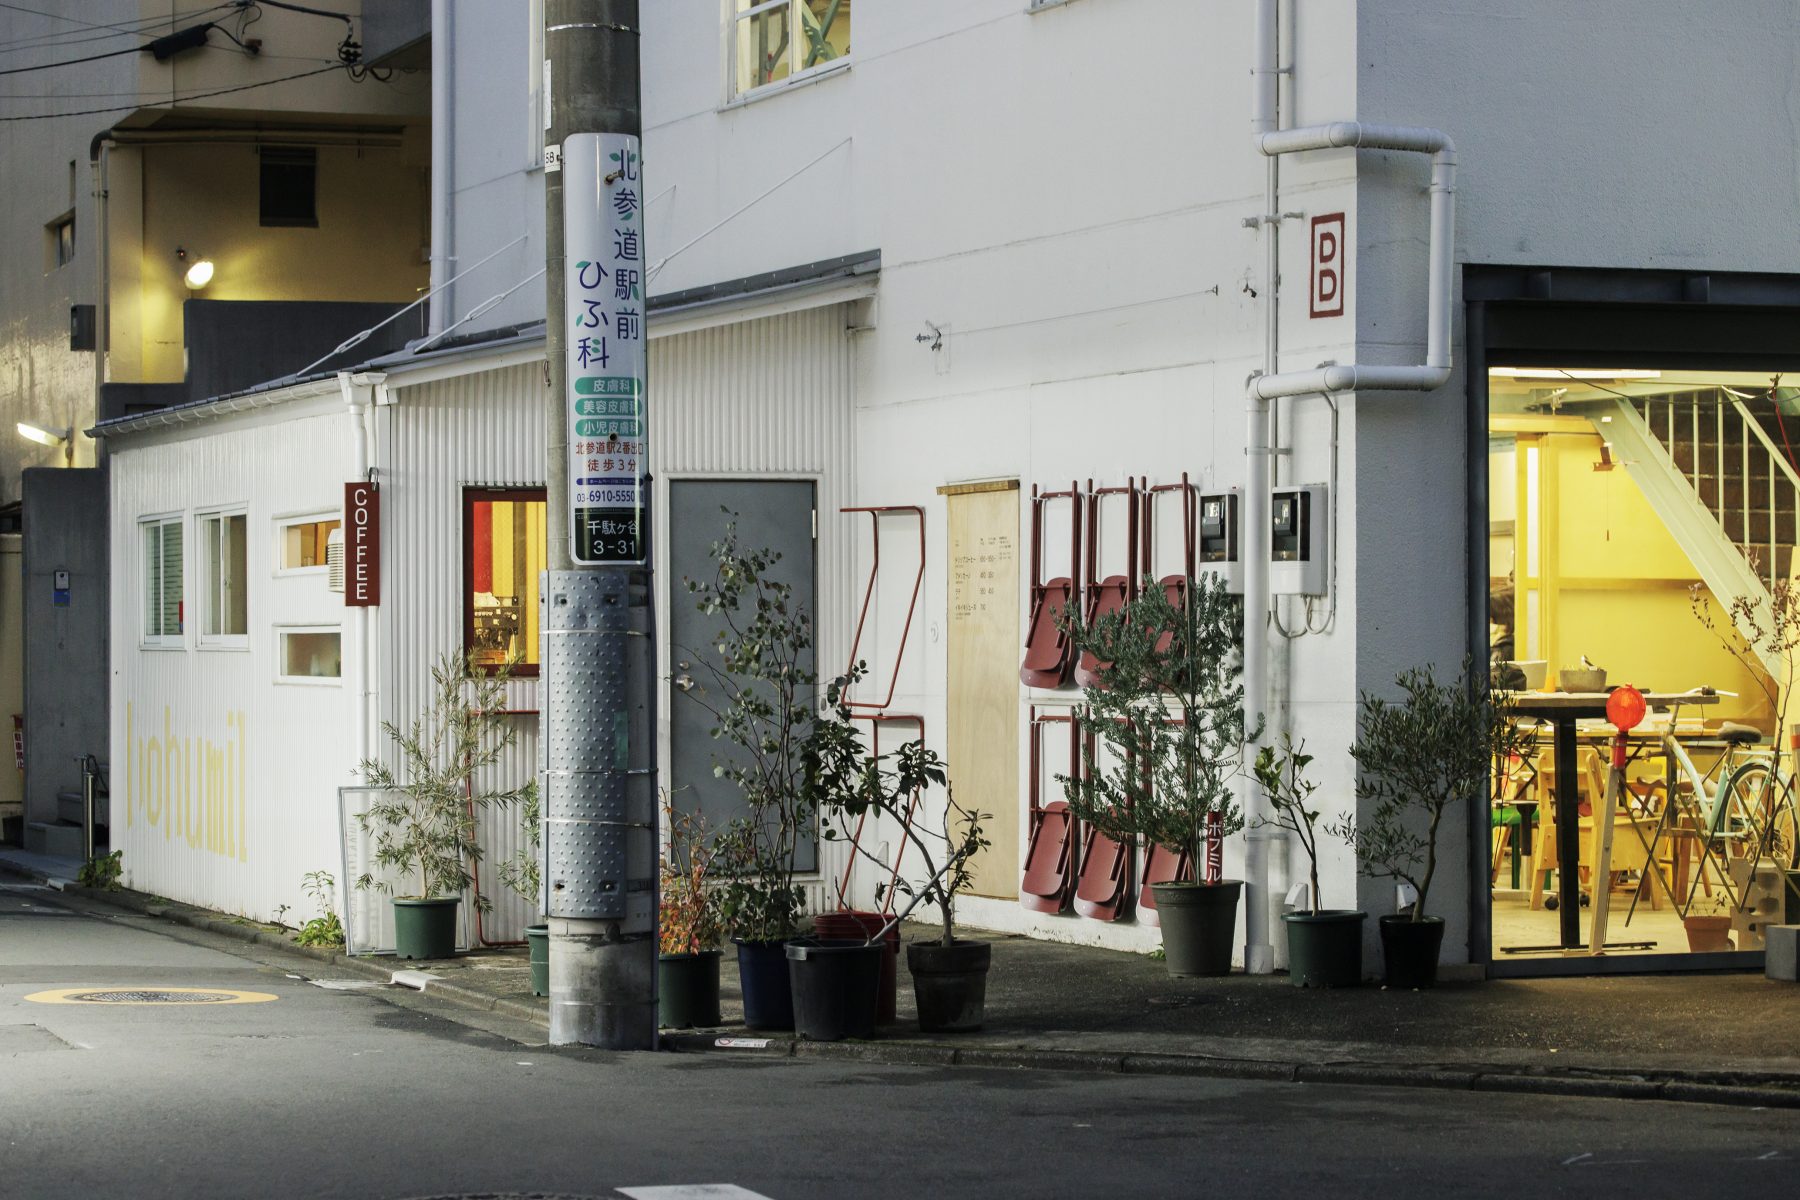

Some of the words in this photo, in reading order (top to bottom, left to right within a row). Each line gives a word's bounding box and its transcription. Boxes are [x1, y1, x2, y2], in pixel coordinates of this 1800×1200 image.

[613, 149, 639, 340] 北参道駅前
[577, 261, 610, 369] ひふ科
[593, 379, 630, 393] 皮膚科
[583, 421, 637, 435] 小児皮膚科
[575, 441, 644, 455] 北参道駅2番出口
[587, 520, 639, 535] 千駄ヶ谷
[354, 488, 368, 600] COFFEE
[593, 540, 635, 555] 3-31
[1208, 821, 1222, 882] ボフミル
